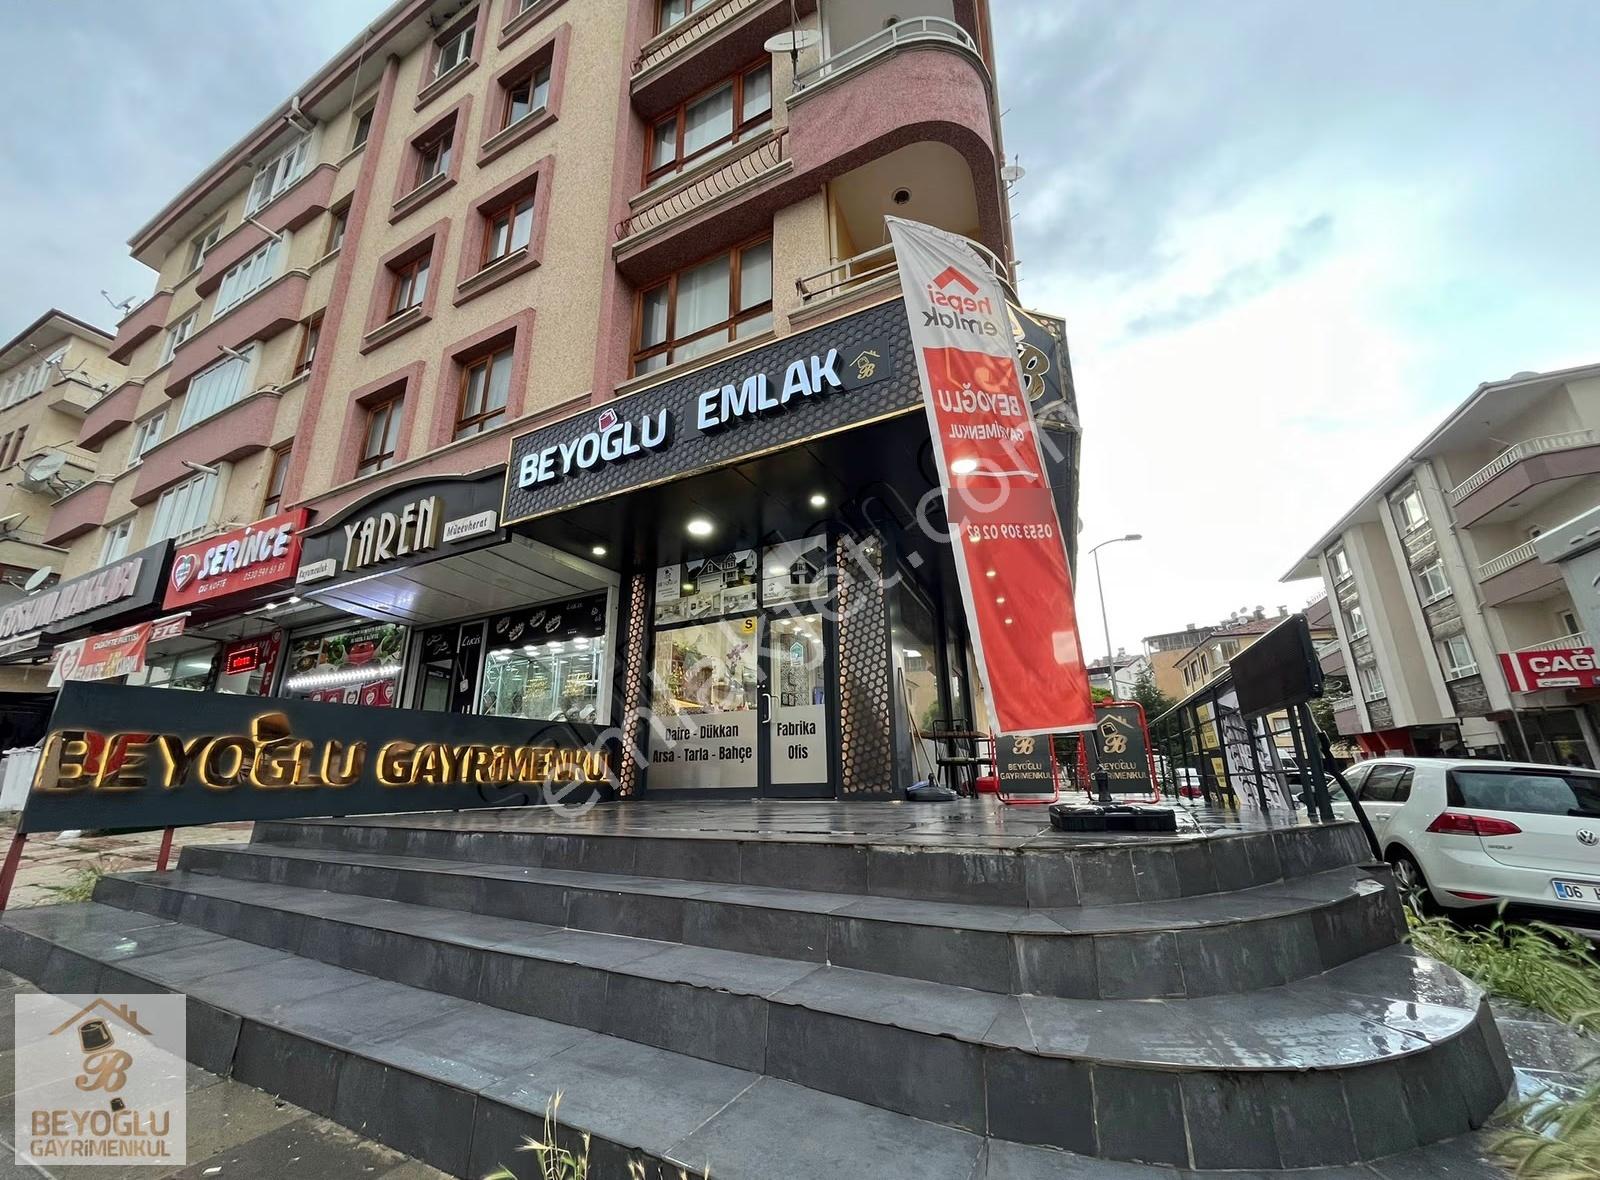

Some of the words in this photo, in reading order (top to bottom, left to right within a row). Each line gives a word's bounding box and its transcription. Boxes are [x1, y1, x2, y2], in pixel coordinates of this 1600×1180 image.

[697, 348, 843, 431] EMLAK
[342, 496, 437, 571] YAREN
[198, 522, 293, 580] SERİNCE
[1529, 650, 1600, 677] ÇAĞ
[666, 728, 690, 742] Daire
[700, 724, 739, 739] Dükkan
[777, 721, 816, 736] Fabrika
[653, 749, 675, 763] Arsa
[684, 747, 709, 762] Tarla
[719, 746, 752, 763] Bahçe
[788, 744, 808, 759] Ofis
[1564, 885, 1583, 899] 06
